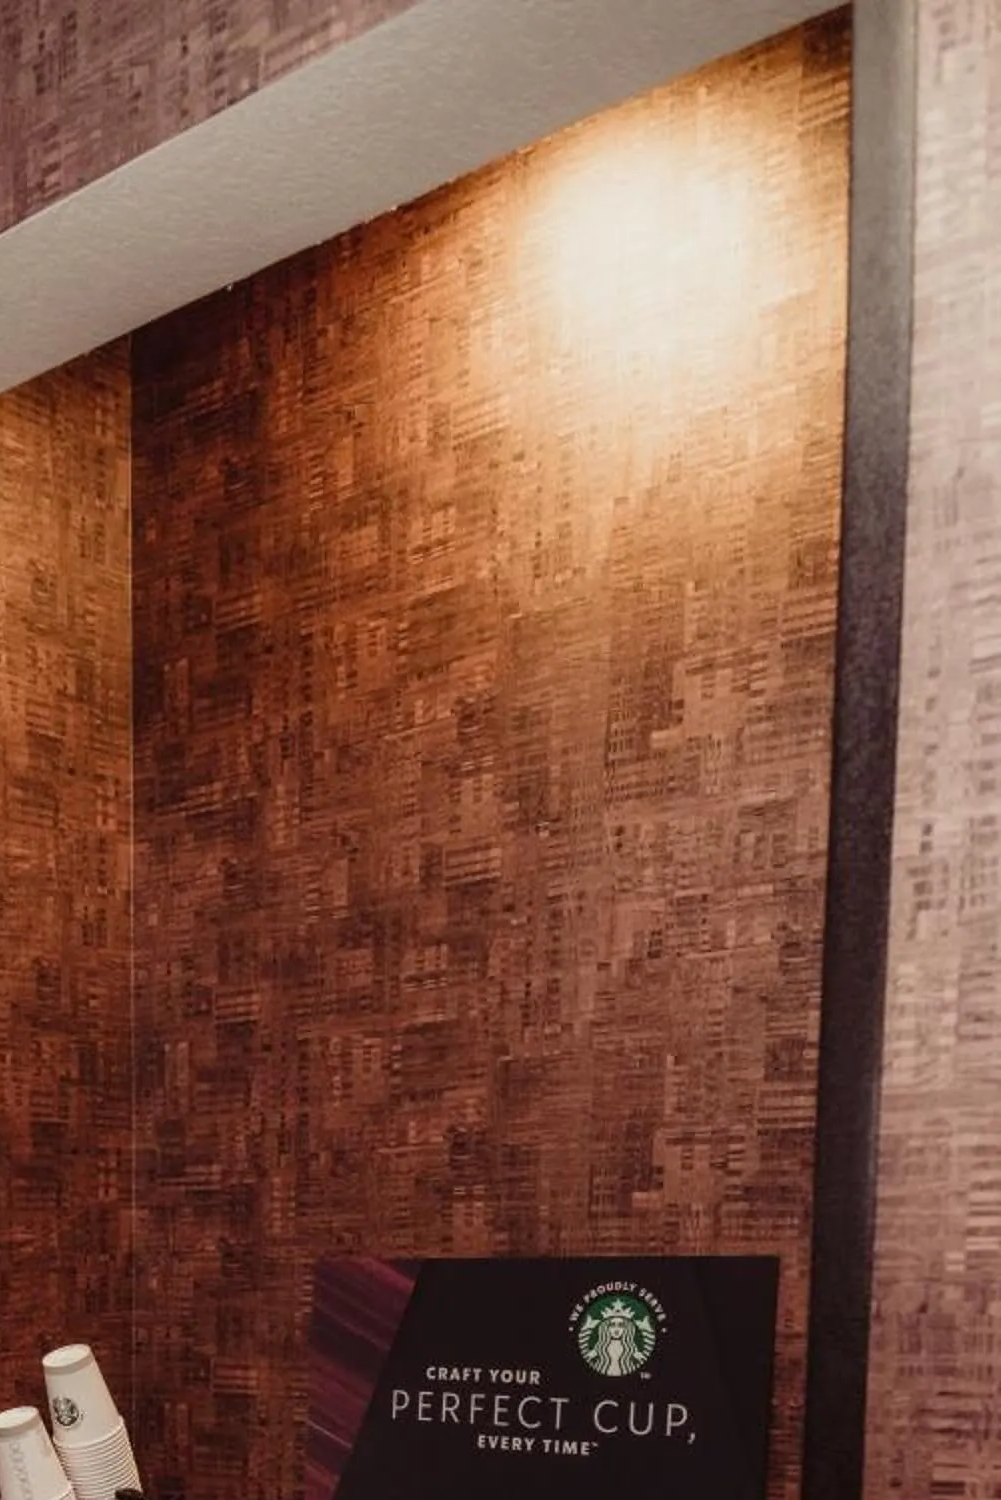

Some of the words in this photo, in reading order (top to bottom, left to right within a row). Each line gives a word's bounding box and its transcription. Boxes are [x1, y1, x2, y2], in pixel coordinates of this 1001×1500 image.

[582, 1281, 638, 1304] PROUDLY
[425, 1366, 482, 1383] CRAFT
[489, 1369, 541, 1385] YOUR
[391, 1389, 570, 1431] PERFECT
[593, 1399, 697, 1445] CUP,
[477, 1434, 536, 1452] EVERY
